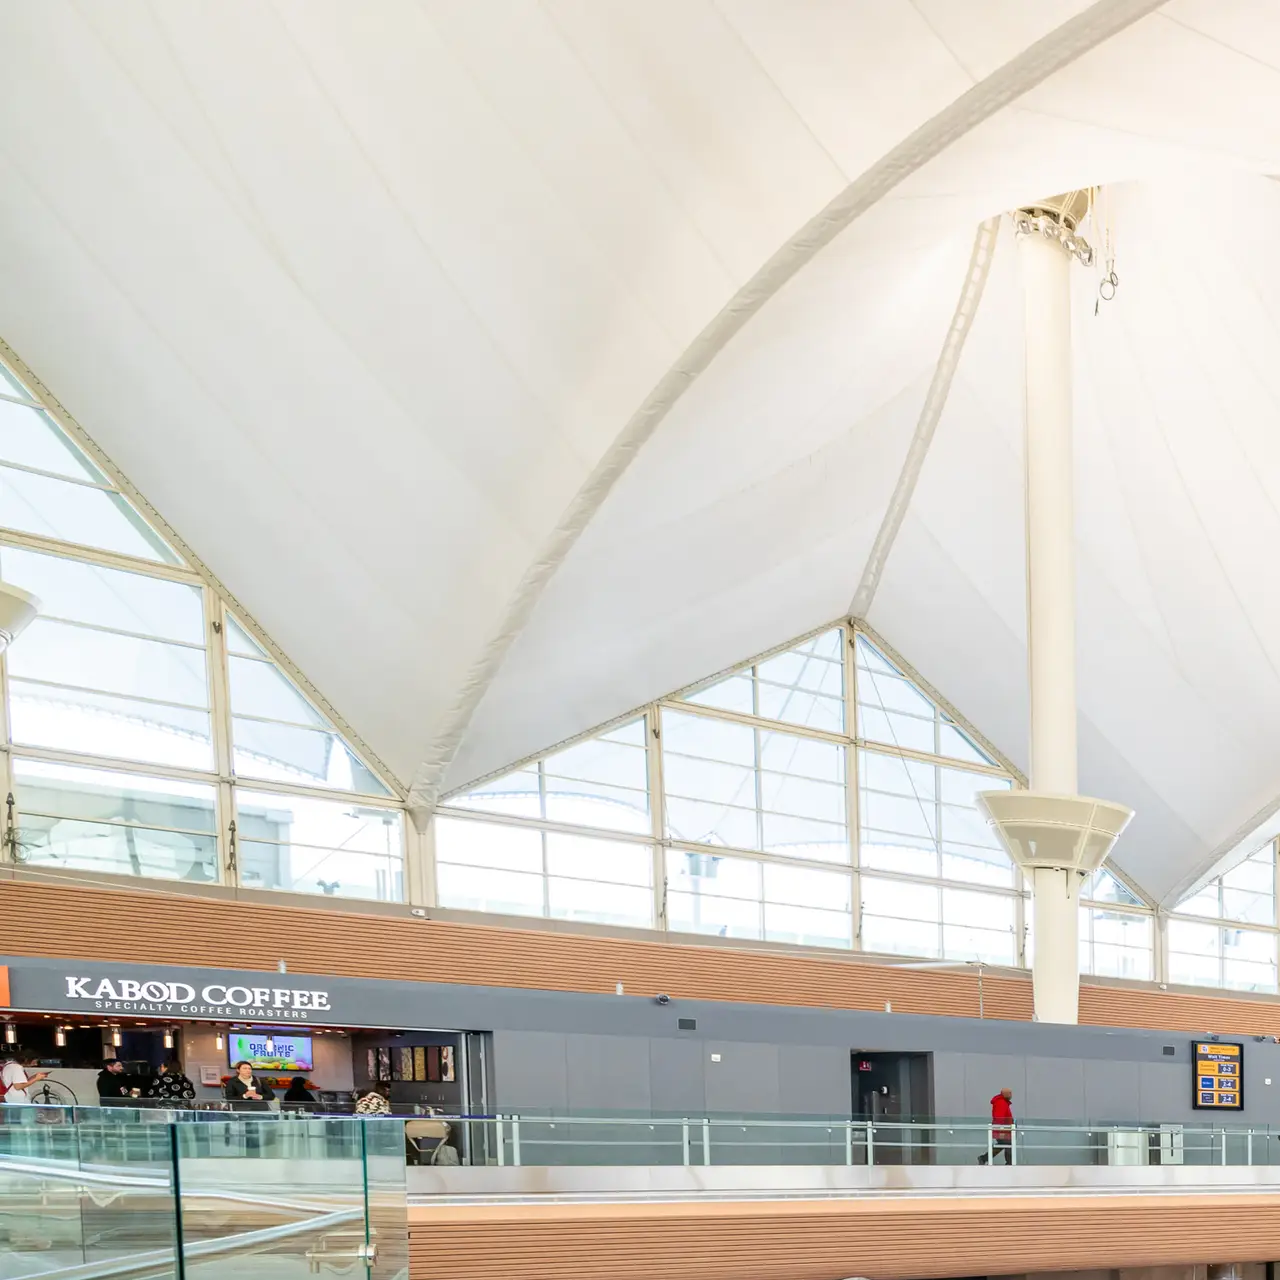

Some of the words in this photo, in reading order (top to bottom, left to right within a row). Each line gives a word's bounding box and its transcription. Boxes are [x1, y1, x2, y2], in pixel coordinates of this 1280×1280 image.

[65, 976, 196, 1004] KABOD
[201, 984, 331, 1011] COFFEE
[95, 1001, 173, 1012] SPECIALTY
[181, 1004, 232, 1015] COFFEE
[239, 1008, 308, 1019] ROASTERS
